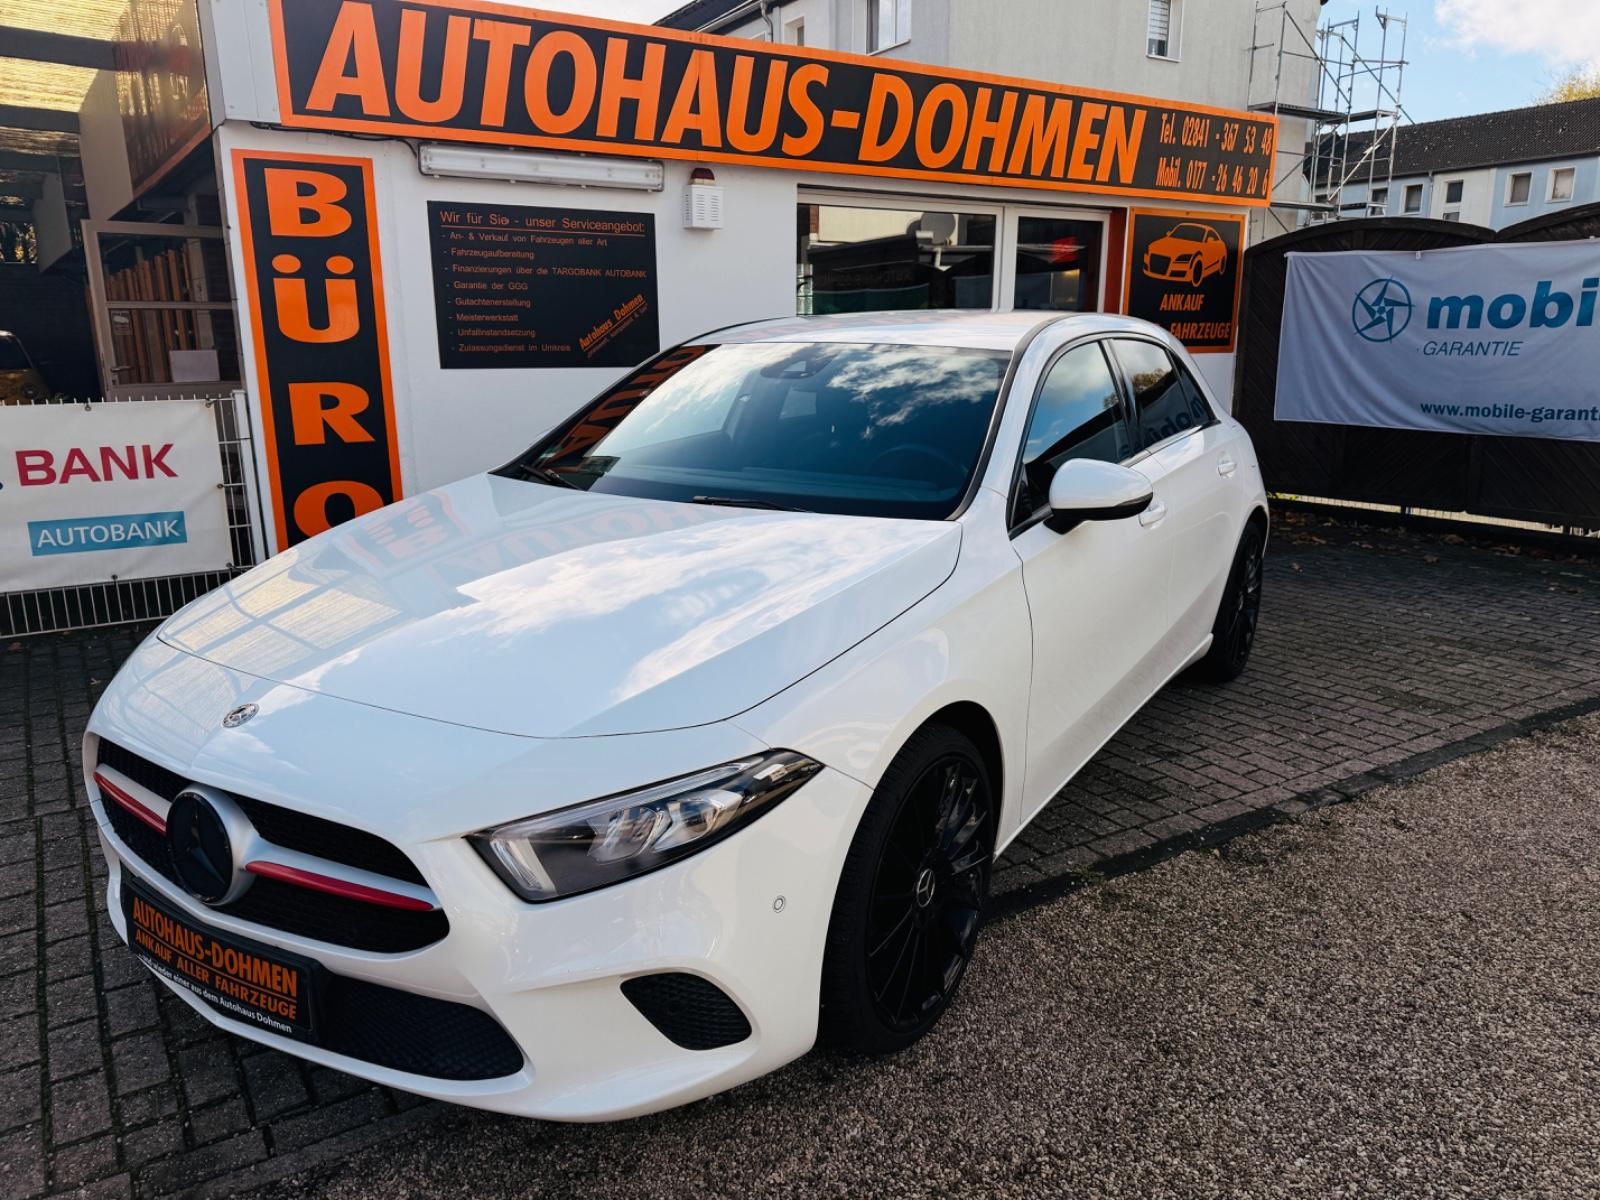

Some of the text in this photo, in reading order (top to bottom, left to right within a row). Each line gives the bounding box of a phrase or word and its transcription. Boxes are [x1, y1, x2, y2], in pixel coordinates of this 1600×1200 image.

[305, 0, 1147, 186] AUTOHAUS-DOHMEN
[1160, 113, 1176, 145] Tel.
[1182, 115, 1210, 148] 02841
[1243, 125, 1256, 154] 53
[1261, 127, 1273, 156] 48
[1155, 156, 1182, 188] Mobil.
[1185, 160, 1208, 190] 0177
[1232, 165, 1244, 194] 46
[1246, 166, 1259, 195] 20
[1262, 168, 1269, 196] 6
[440, 211, 461, 224] Wir
[466, 212, 483, 224] für
[489, 213, 510, 225] Sie
[525, 217, 556, 228] unser
[562, 217, 646, 234] Serviceangebot:
[479, 232, 509, 242] Verkauf
[512, 235, 527, 243] von
[531, 235, 574, 247] Fahrzeugen
[597, 238, 608, 247] Art
[451, 247, 535, 260] Fahrzeugaufbereitung
[452, 263, 512, 276] Finanzierungen
[516, 266, 533, 275] über
[536, 267, 549, 276] die
[552, 267, 602, 277] TARGOBANK
[605, 269, 647, 279] AUTOBANK
[453, 280, 488, 290] Garantie
[491, 282, 505, 290] der
[508, 282, 529, 291] GGG
[1160, 293, 1205, 311] ANKAUF
[1426, 277, 1600, 330] mobi
[456, 313, 519, 322] Meisterwerkstatt
[578, 318, 613, 350] Autohaus
[613, 293, 644, 321] Dohmen
[1170, 322, 1231, 339] FAHRZEUGE
[263, 167, 386, 538] BÜRO
[528, 344, 538, 352] im
[1423, 341, 1524, 356] GARANTIE
[1420, 402, 1600, 423] www.mobile-garant
[15, 443, 178, 487] BANK
[37, 518, 181, 549] AUTOBANK
[133, 896, 298, 998] AUTOHAUS-DOHMEN
[135, 929, 297, 1020] ANKAUF ALLER FAHRZEUGE
[203, 988, 219, 1003] dem
[220, 997, 256, 1019] Autohaus
[256, 1012, 293, 1033] Dohmen
